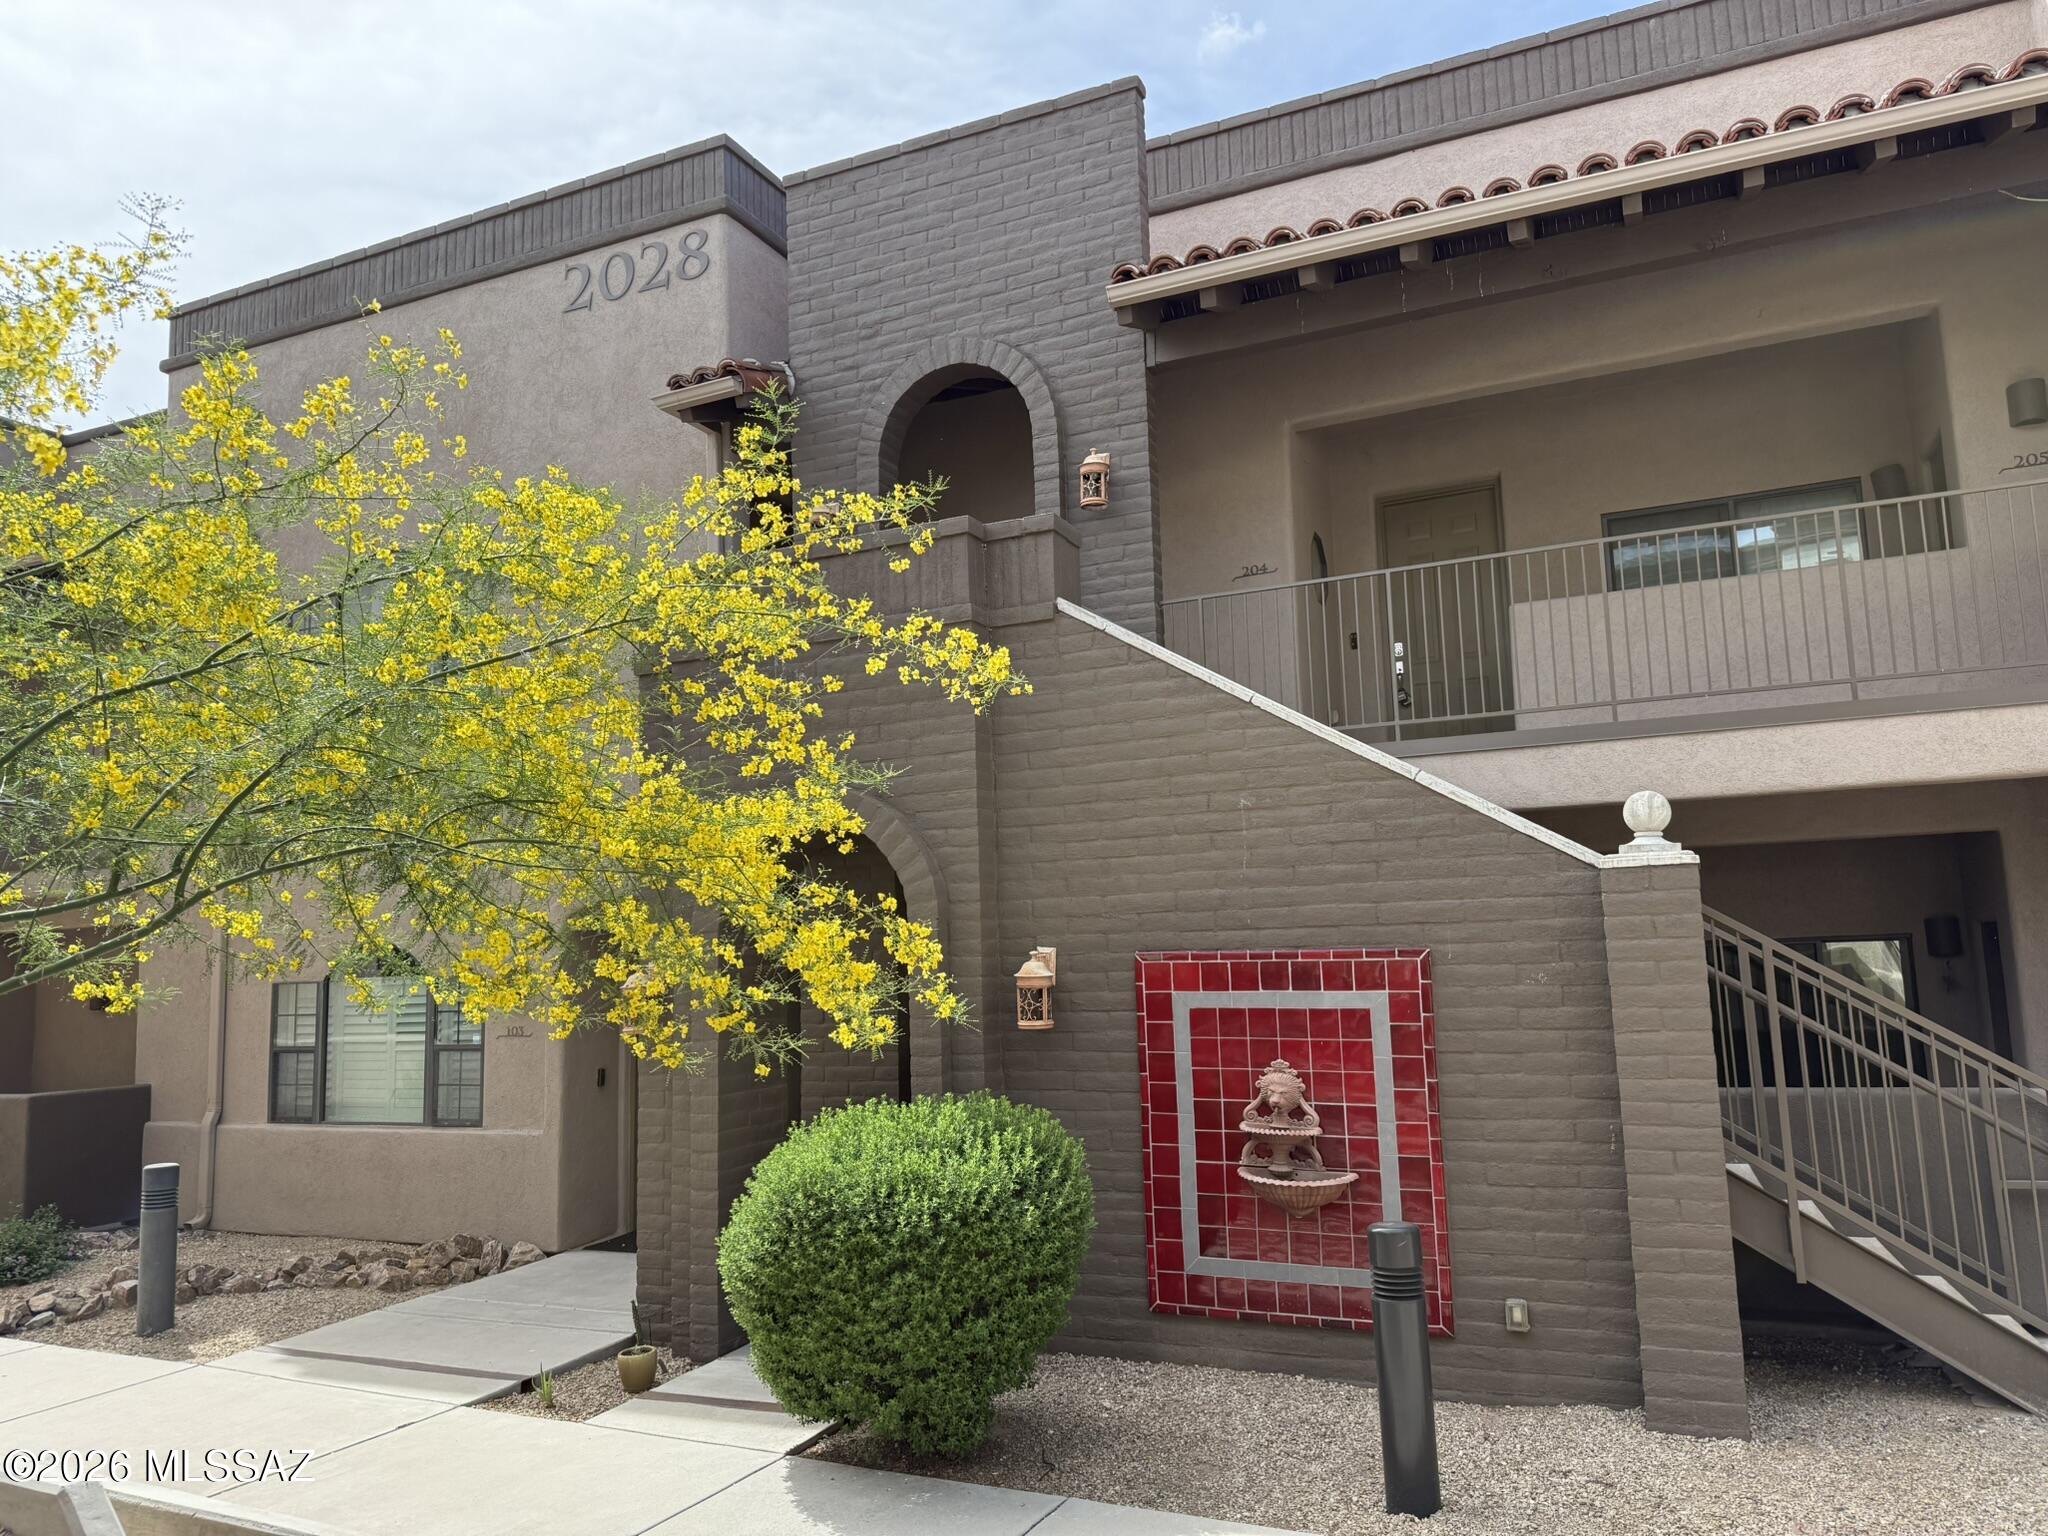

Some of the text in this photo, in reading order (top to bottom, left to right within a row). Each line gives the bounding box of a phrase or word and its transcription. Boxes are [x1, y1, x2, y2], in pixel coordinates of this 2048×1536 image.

[562, 229, 710, 313] 2028
[2013, 451, 2048, 468] 205
[1241, 563, 1268, 577] 204
[507, 1025, 525, 1037] 103
